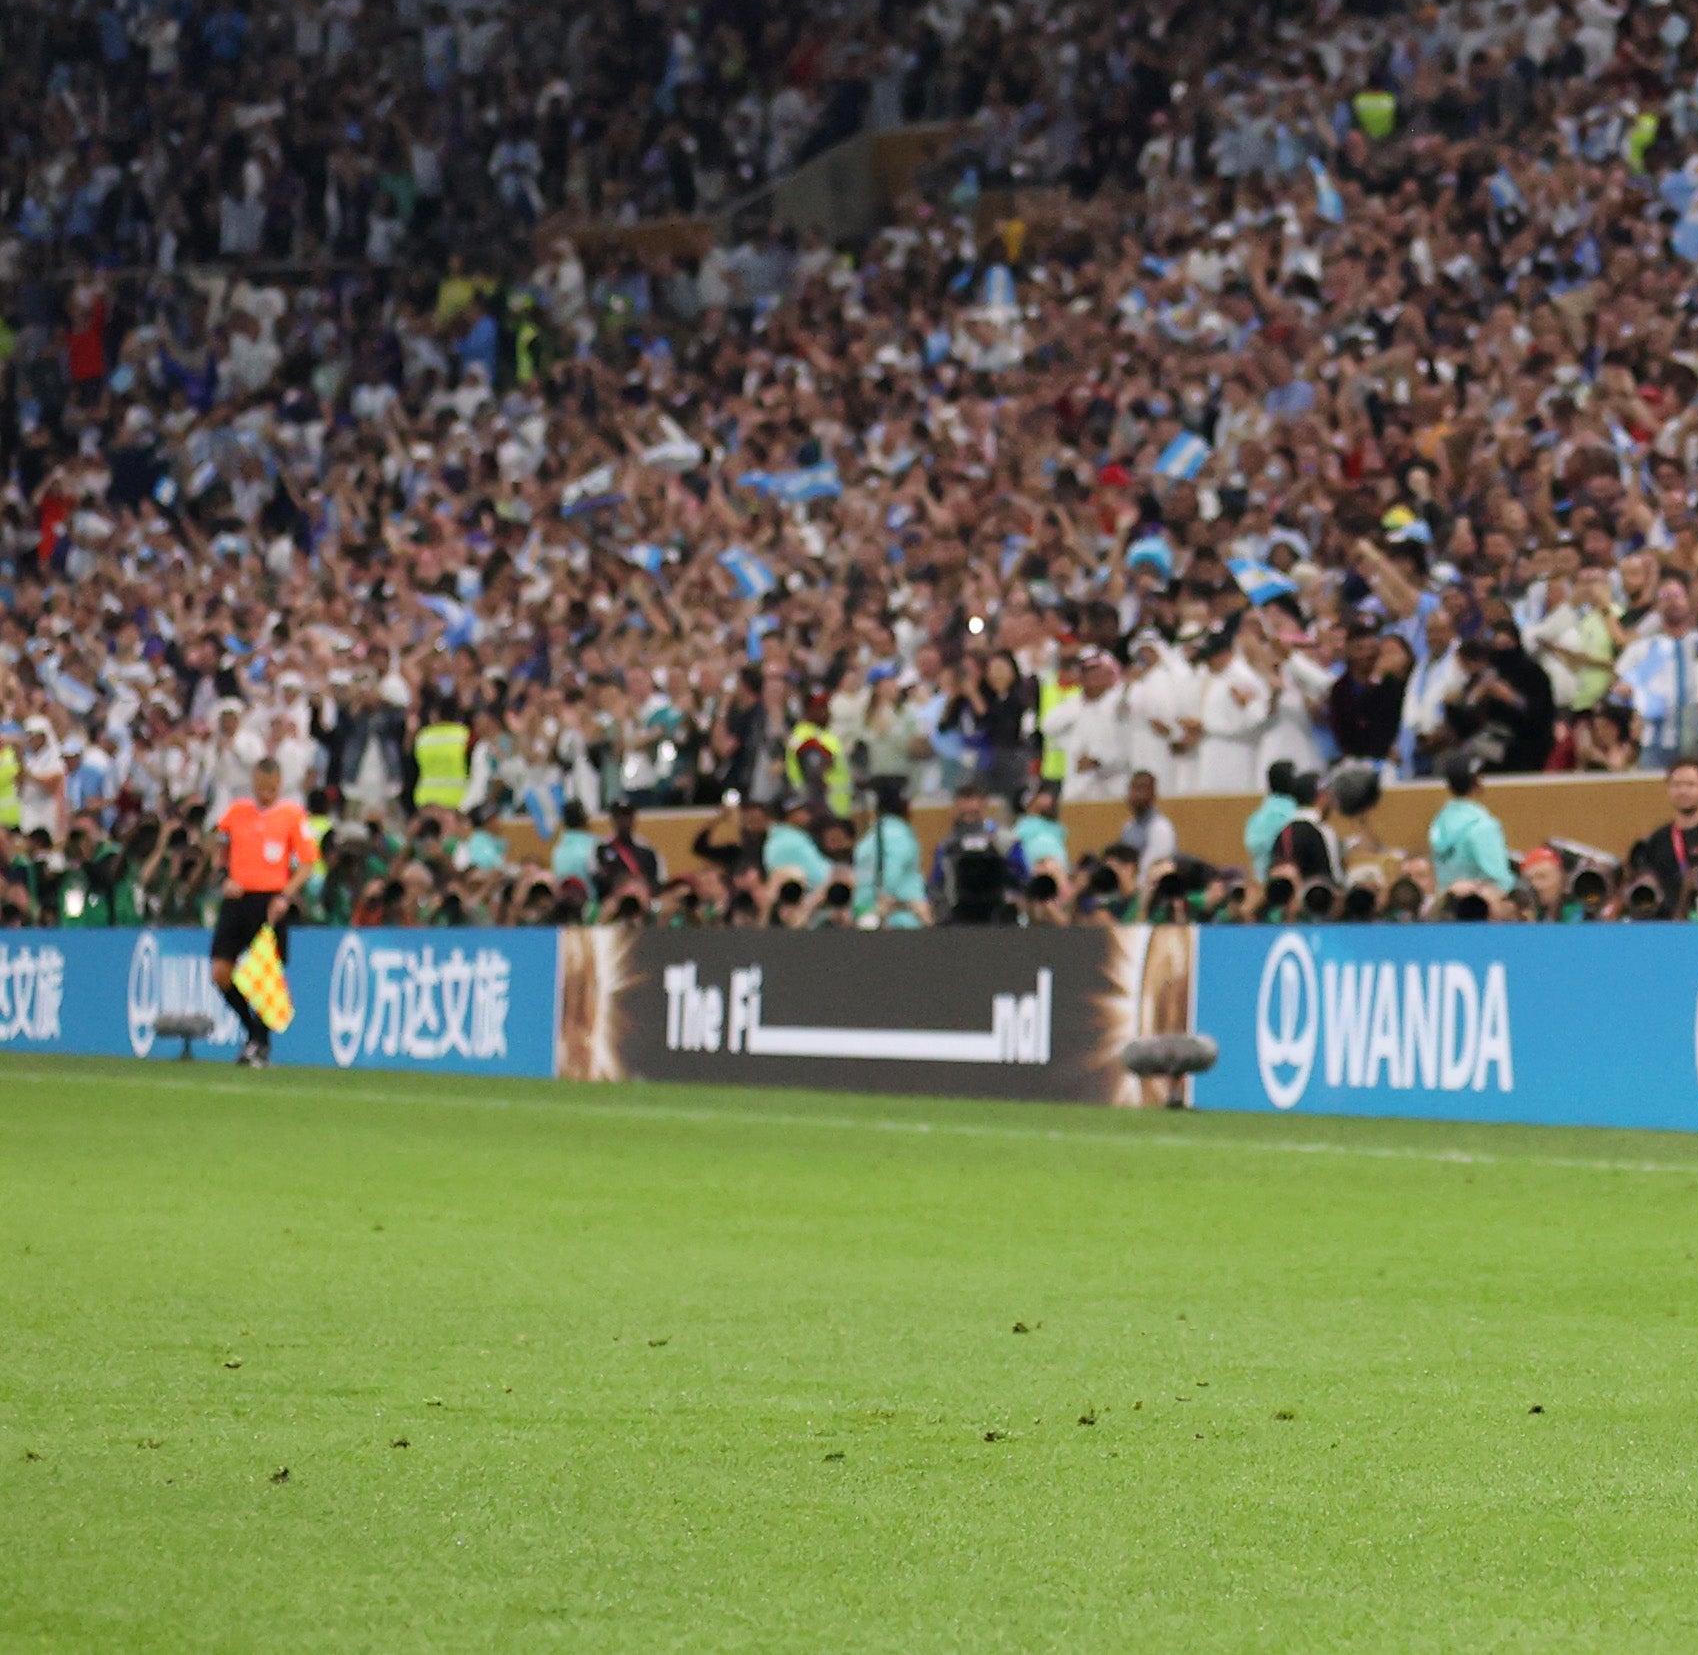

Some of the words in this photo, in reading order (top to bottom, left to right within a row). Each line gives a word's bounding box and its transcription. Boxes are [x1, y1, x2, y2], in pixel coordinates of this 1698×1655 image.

[364, 946, 512, 1060] 万达文旅
[663, 959, 724, 1054] The
[1322, 960, 1514, 1093] WANDA
